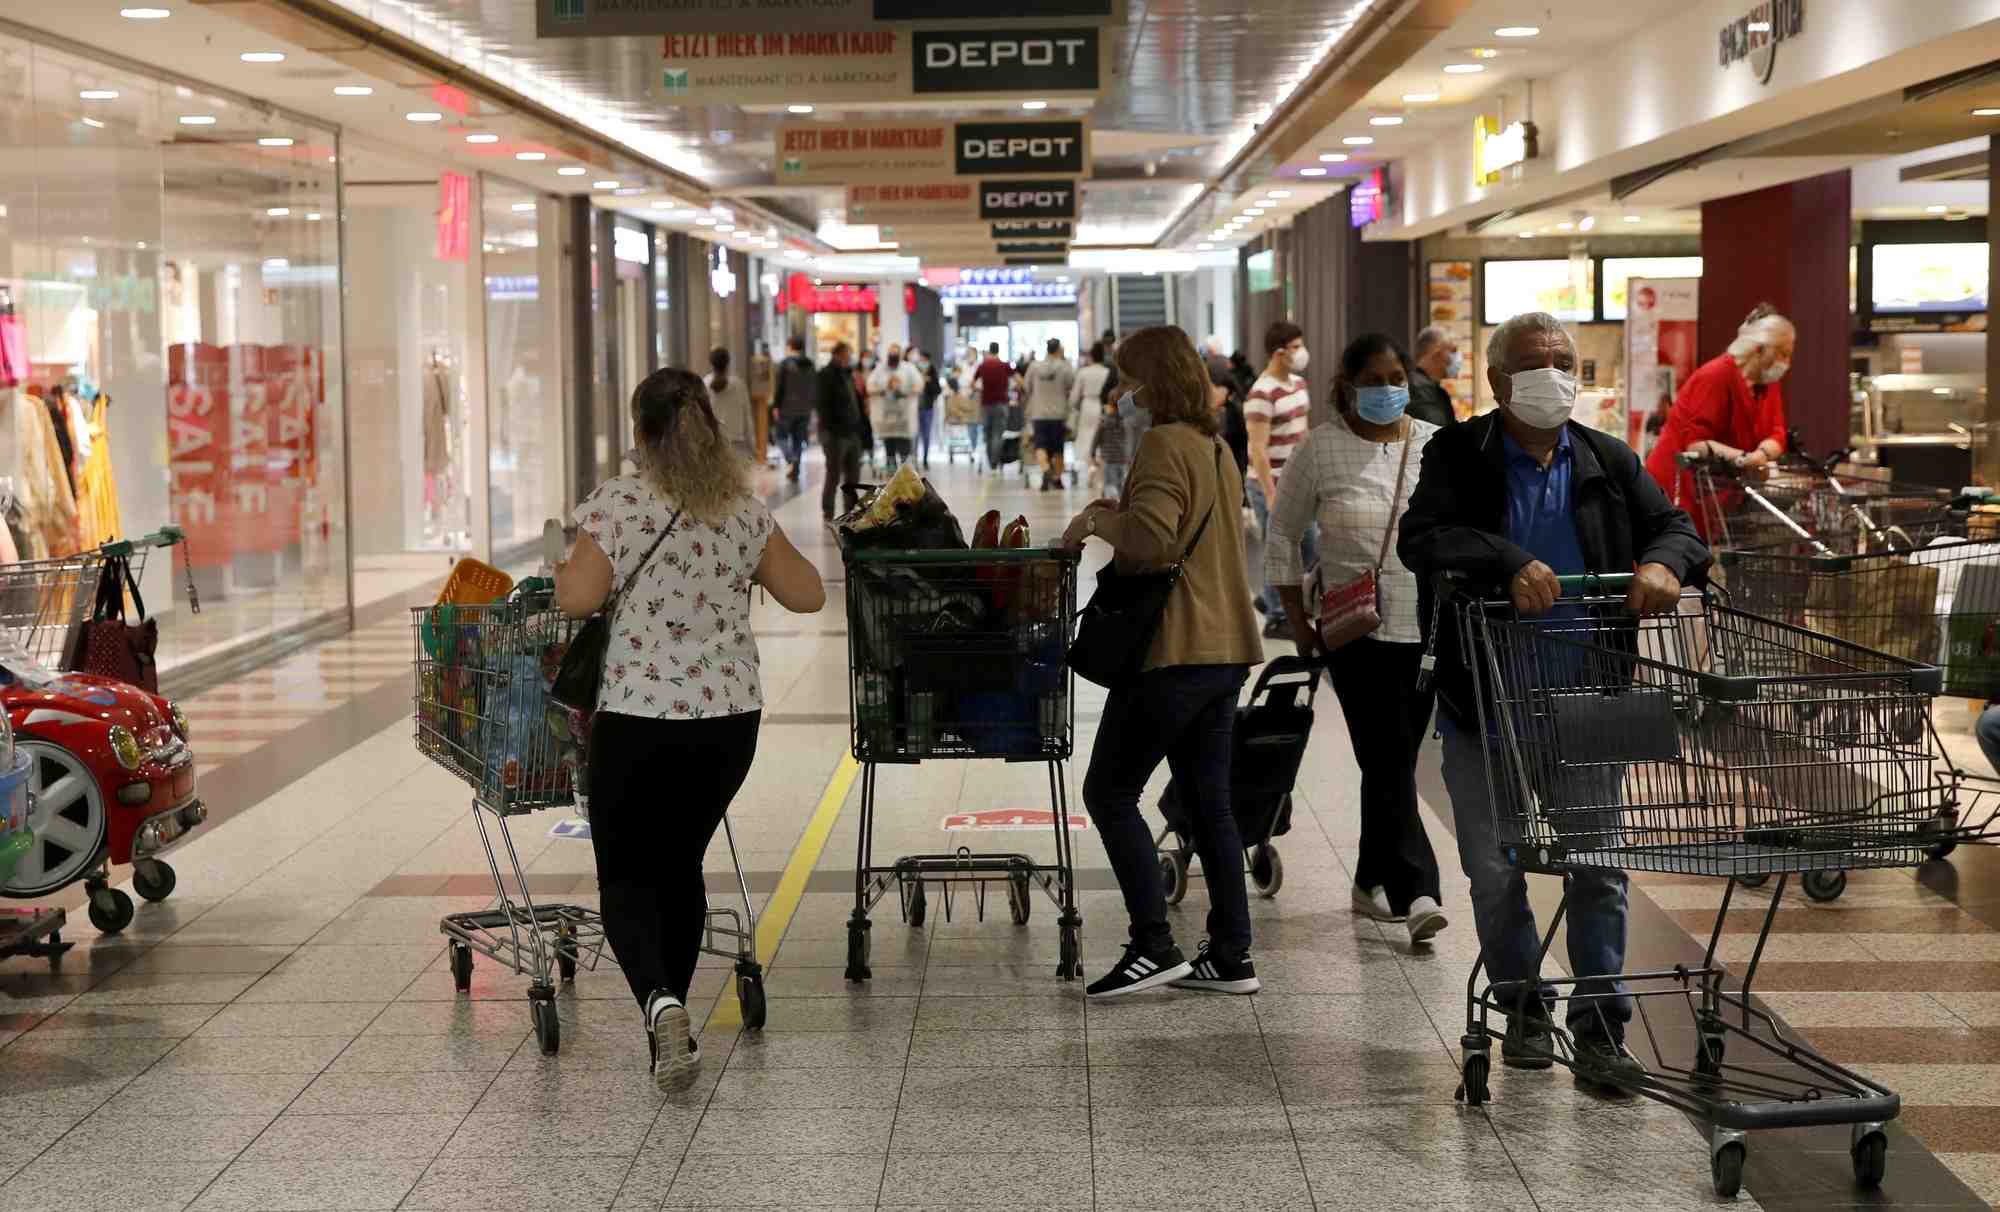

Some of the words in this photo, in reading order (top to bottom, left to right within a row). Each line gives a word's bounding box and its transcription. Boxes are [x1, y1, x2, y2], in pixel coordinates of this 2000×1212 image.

[925, 39, 1086, 68] DEPOT
[963, 137, 1073, 159] DEPOT
[985, 191, 1069, 209] DEPOT
[169, 383, 216, 524] SALE
